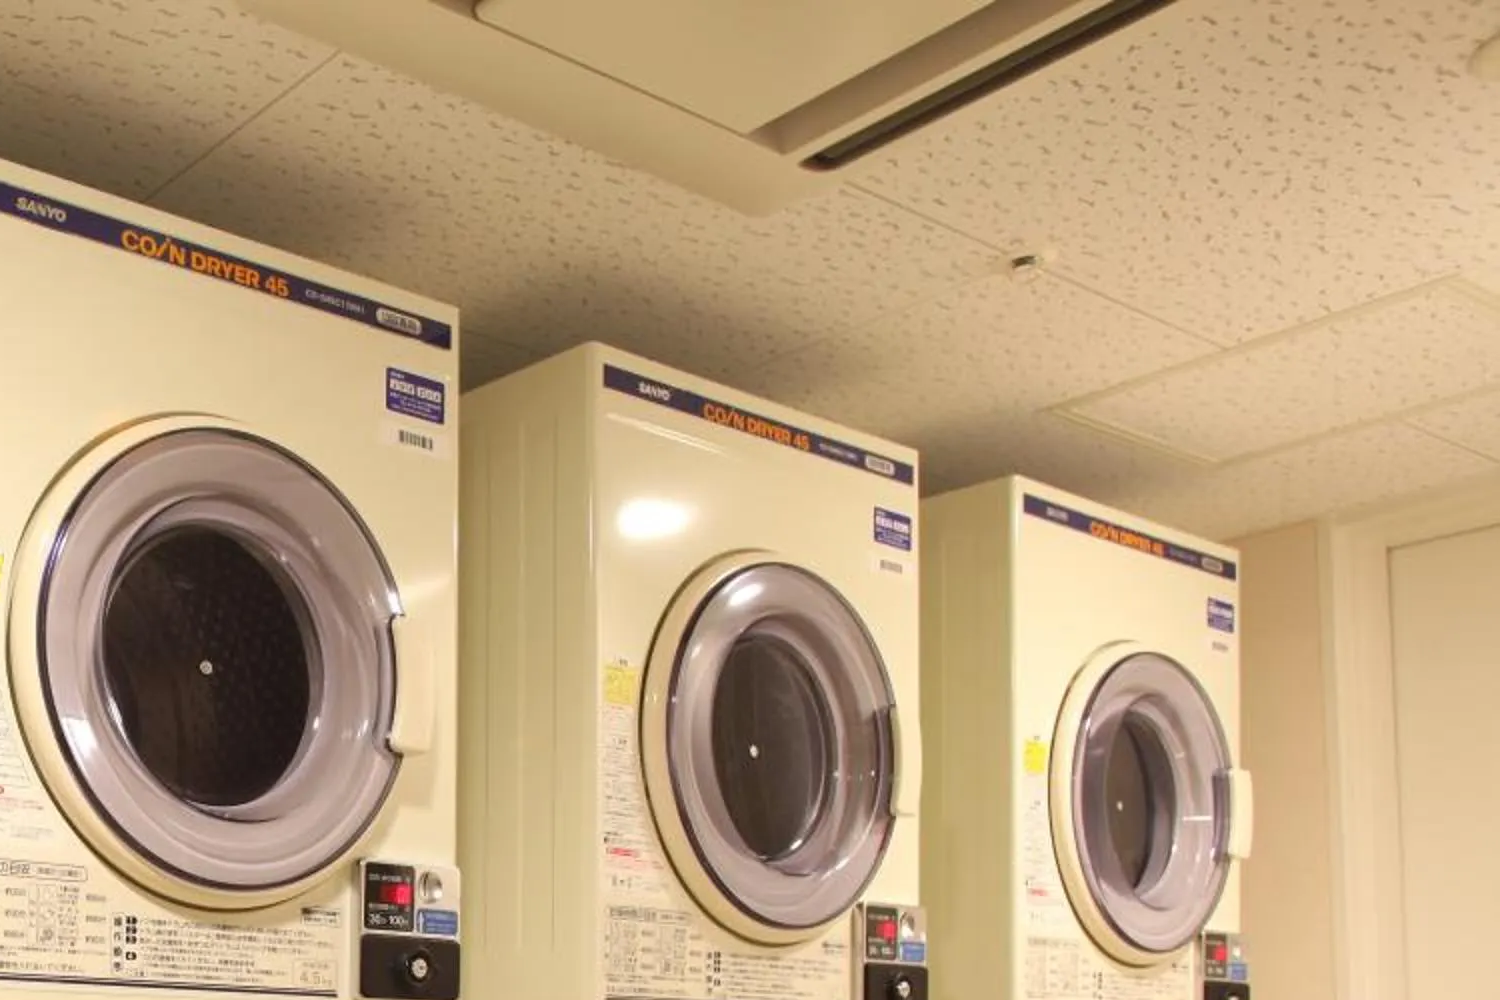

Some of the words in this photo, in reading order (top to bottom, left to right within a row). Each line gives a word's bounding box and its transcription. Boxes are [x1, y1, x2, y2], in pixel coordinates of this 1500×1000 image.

[14, 196, 68, 223] SANYO
[190, 250, 262, 289] DRYER
[264, 275, 291, 298] 45
